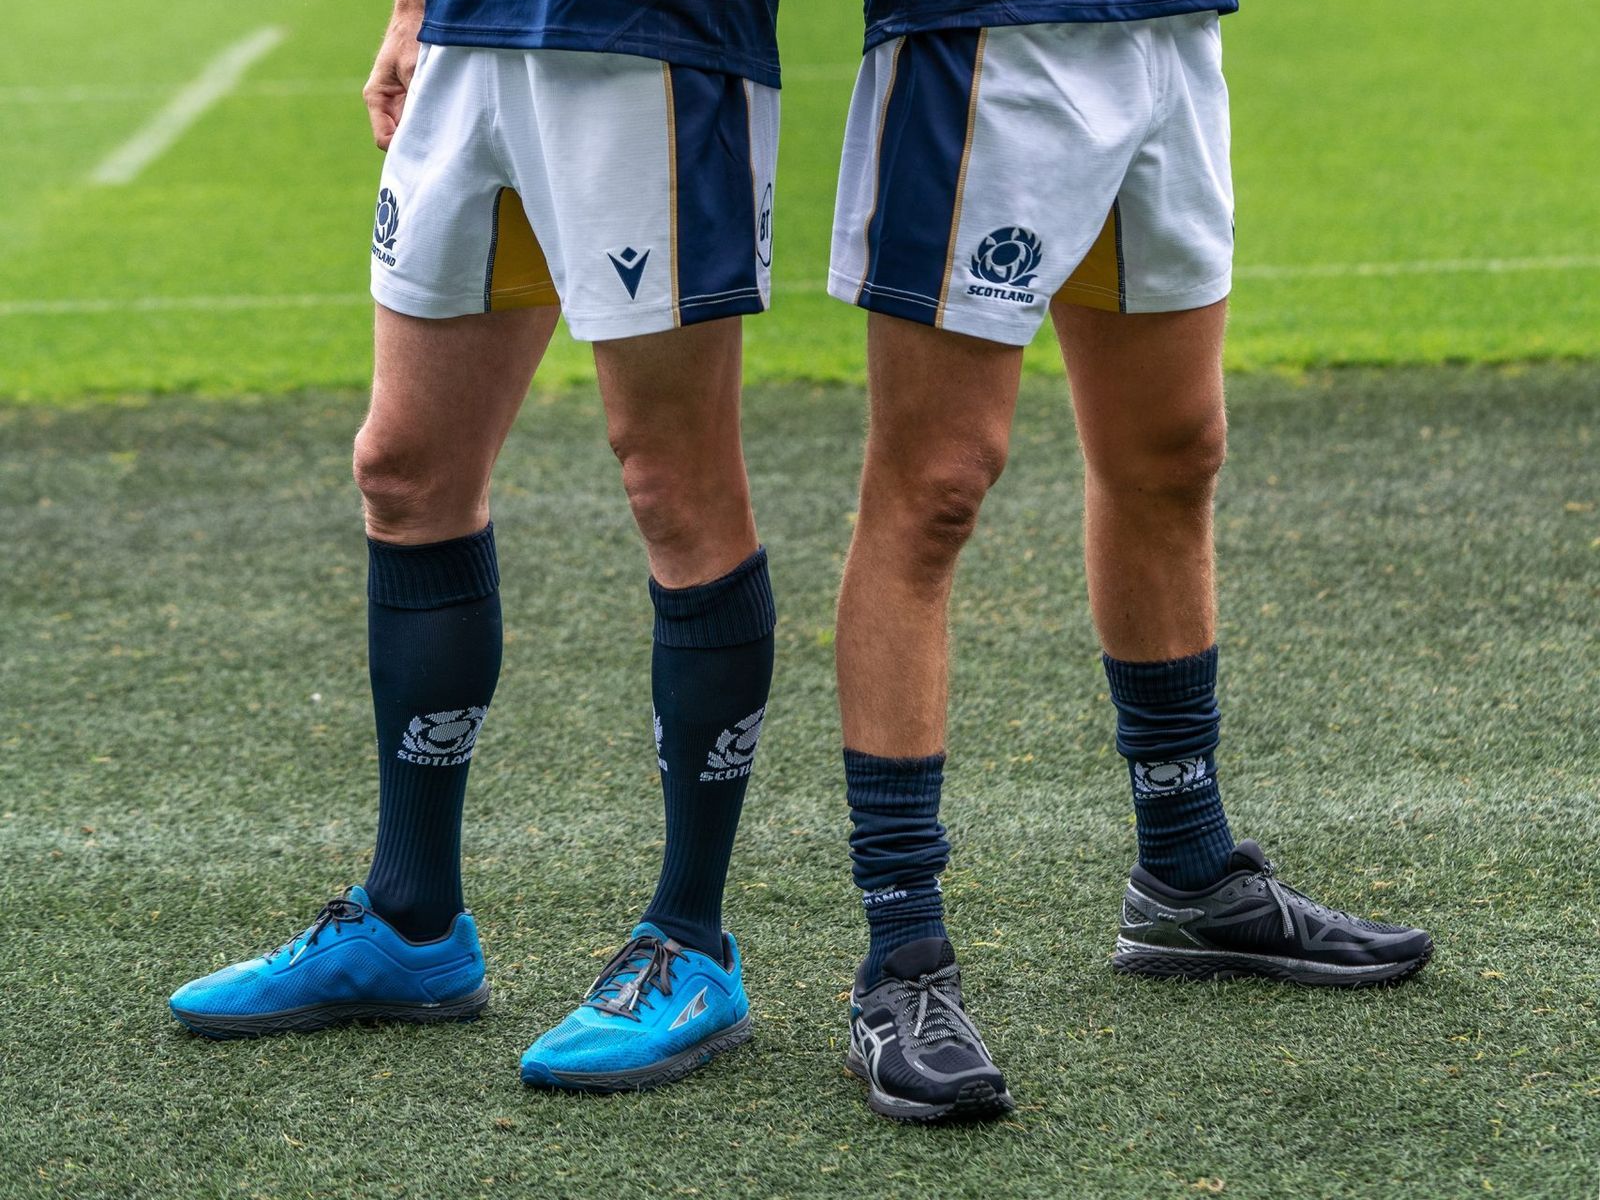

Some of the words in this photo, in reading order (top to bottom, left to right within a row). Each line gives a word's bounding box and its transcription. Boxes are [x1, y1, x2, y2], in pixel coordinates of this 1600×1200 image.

[760, 209, 770, 241] BT
[371, 243, 397, 267] OTLAND
[967, 285, 1035, 304] SCOTLAND
[397, 749, 473, 767] SCOTLAN
